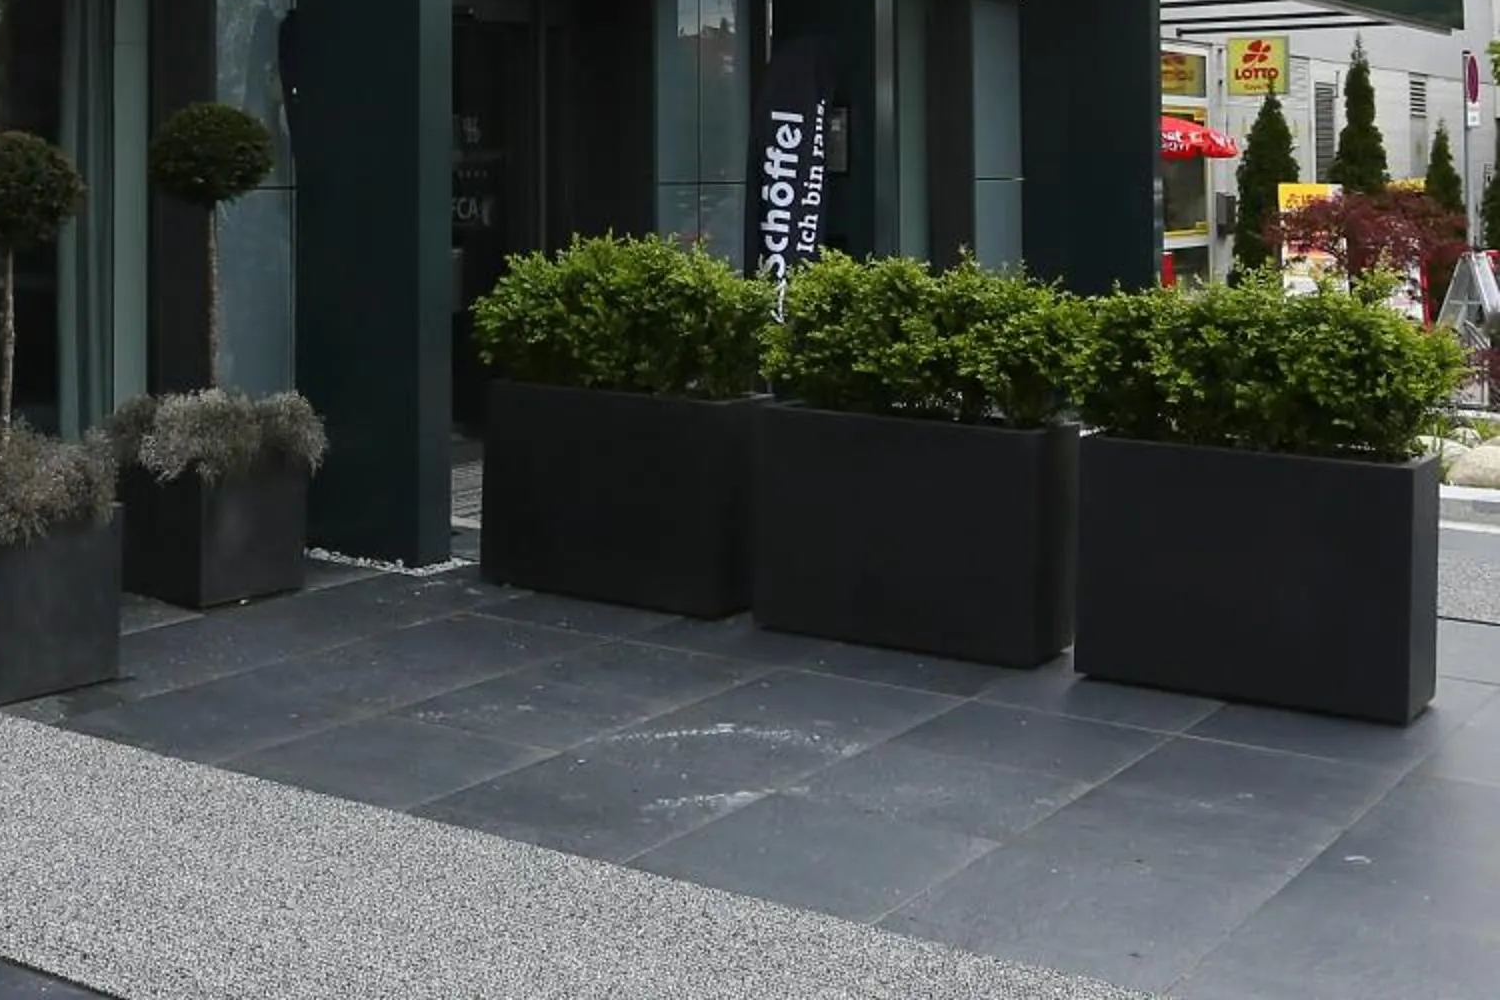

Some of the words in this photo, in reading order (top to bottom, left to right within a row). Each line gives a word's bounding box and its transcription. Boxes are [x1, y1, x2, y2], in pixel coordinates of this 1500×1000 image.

[1234, 66, 1279, 82] LOTTO
[801, 165, 825, 207] bin
[797, 213, 819, 253] Ich
